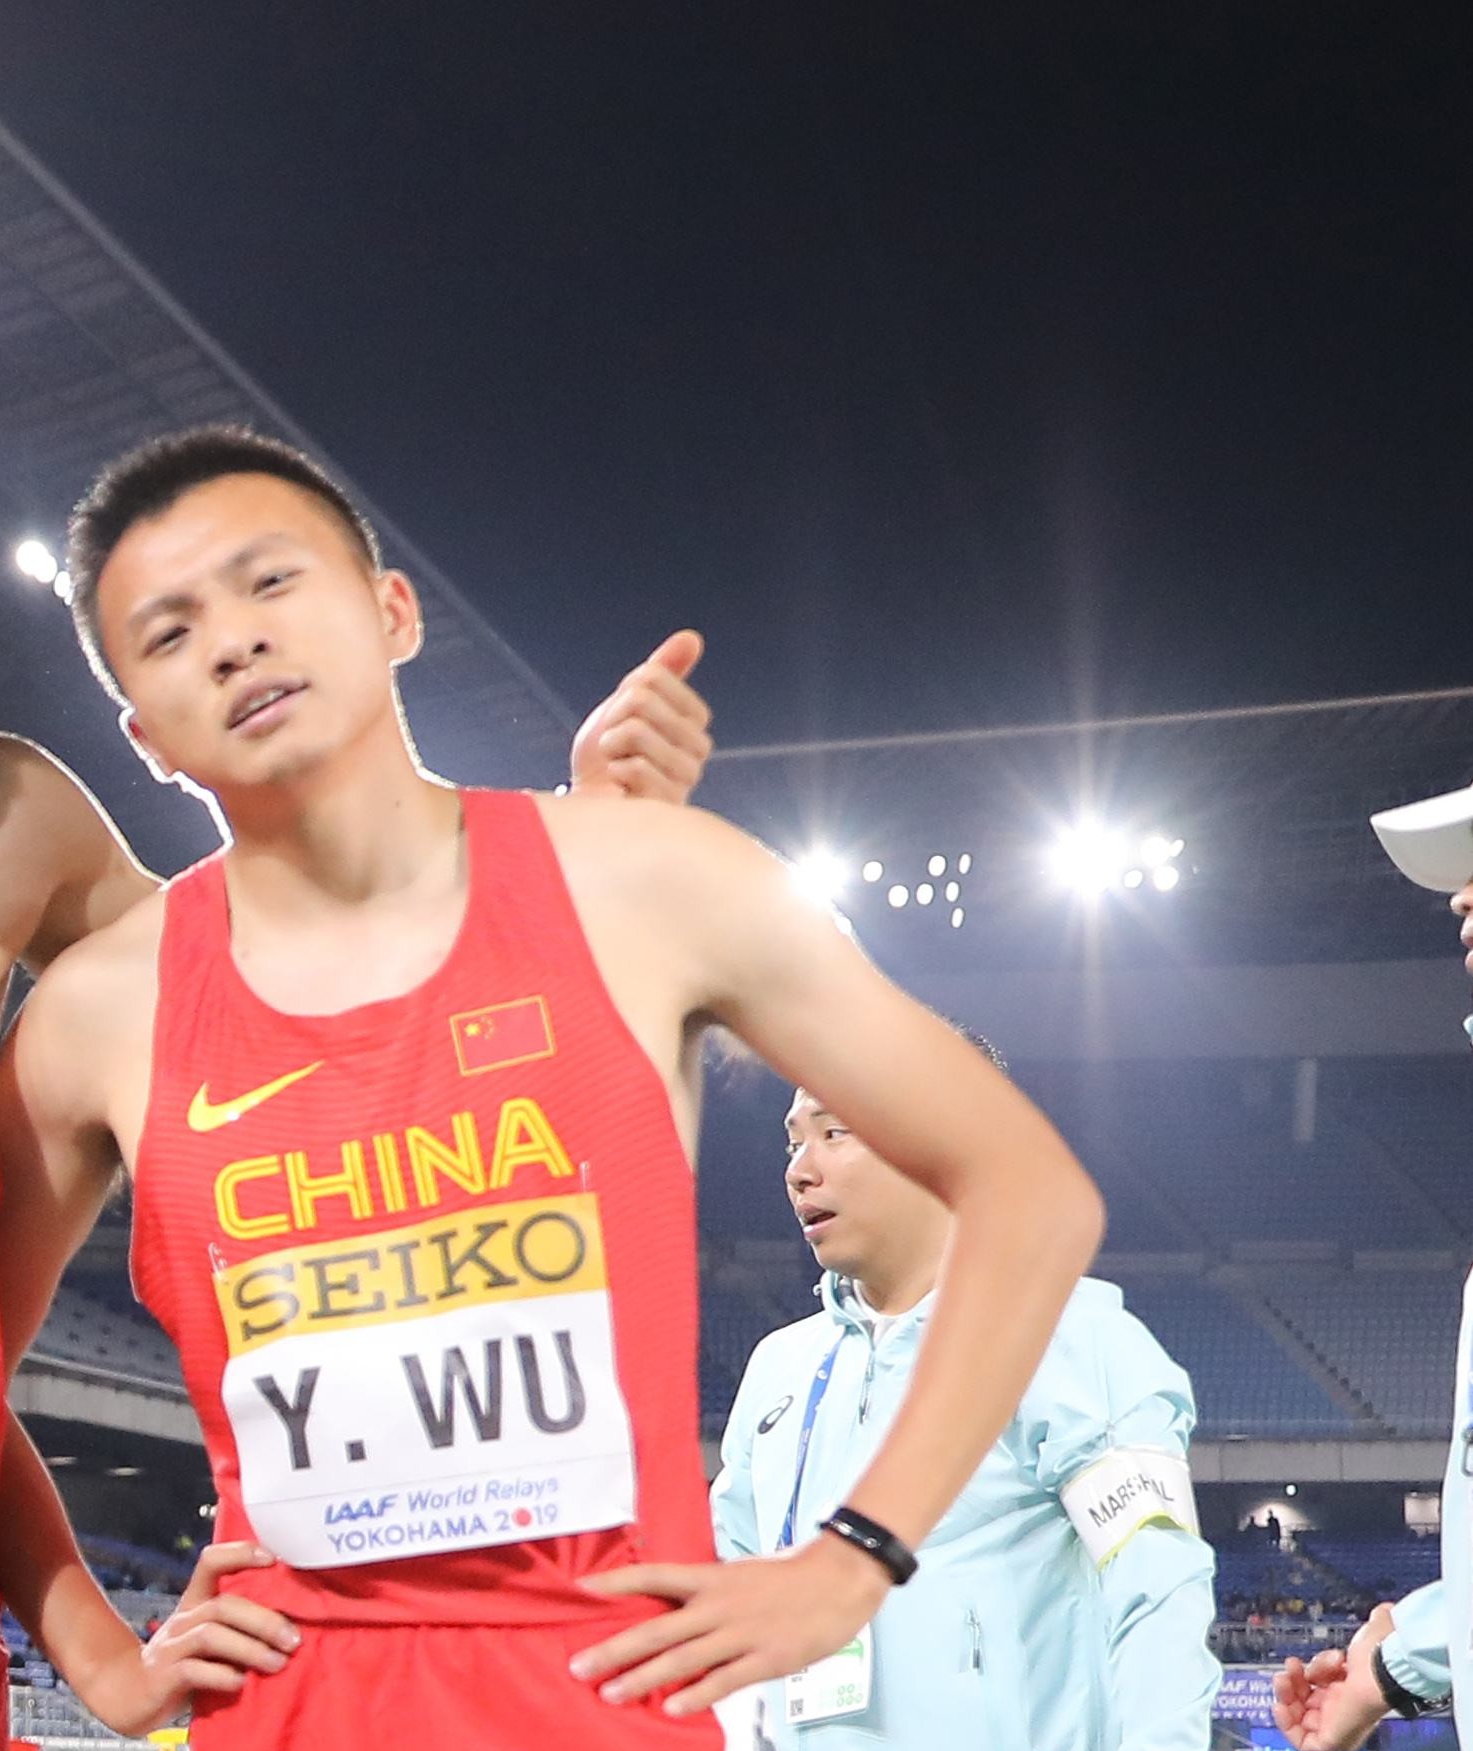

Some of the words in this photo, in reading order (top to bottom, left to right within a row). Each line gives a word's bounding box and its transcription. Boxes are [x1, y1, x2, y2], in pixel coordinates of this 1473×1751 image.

[214, 1097, 574, 1240] CHINA
[234, 1211, 586, 1341] SEIKO
[254, 1366, 367, 1471] Y.
[401, 1330, 587, 1450] WU
[324, 1493, 399, 1525] IAAF
[406, 1486, 480, 1513] World
[485, 1475, 560, 1505] Relays
[326, 1514, 489, 1554] YOKOHAMA
